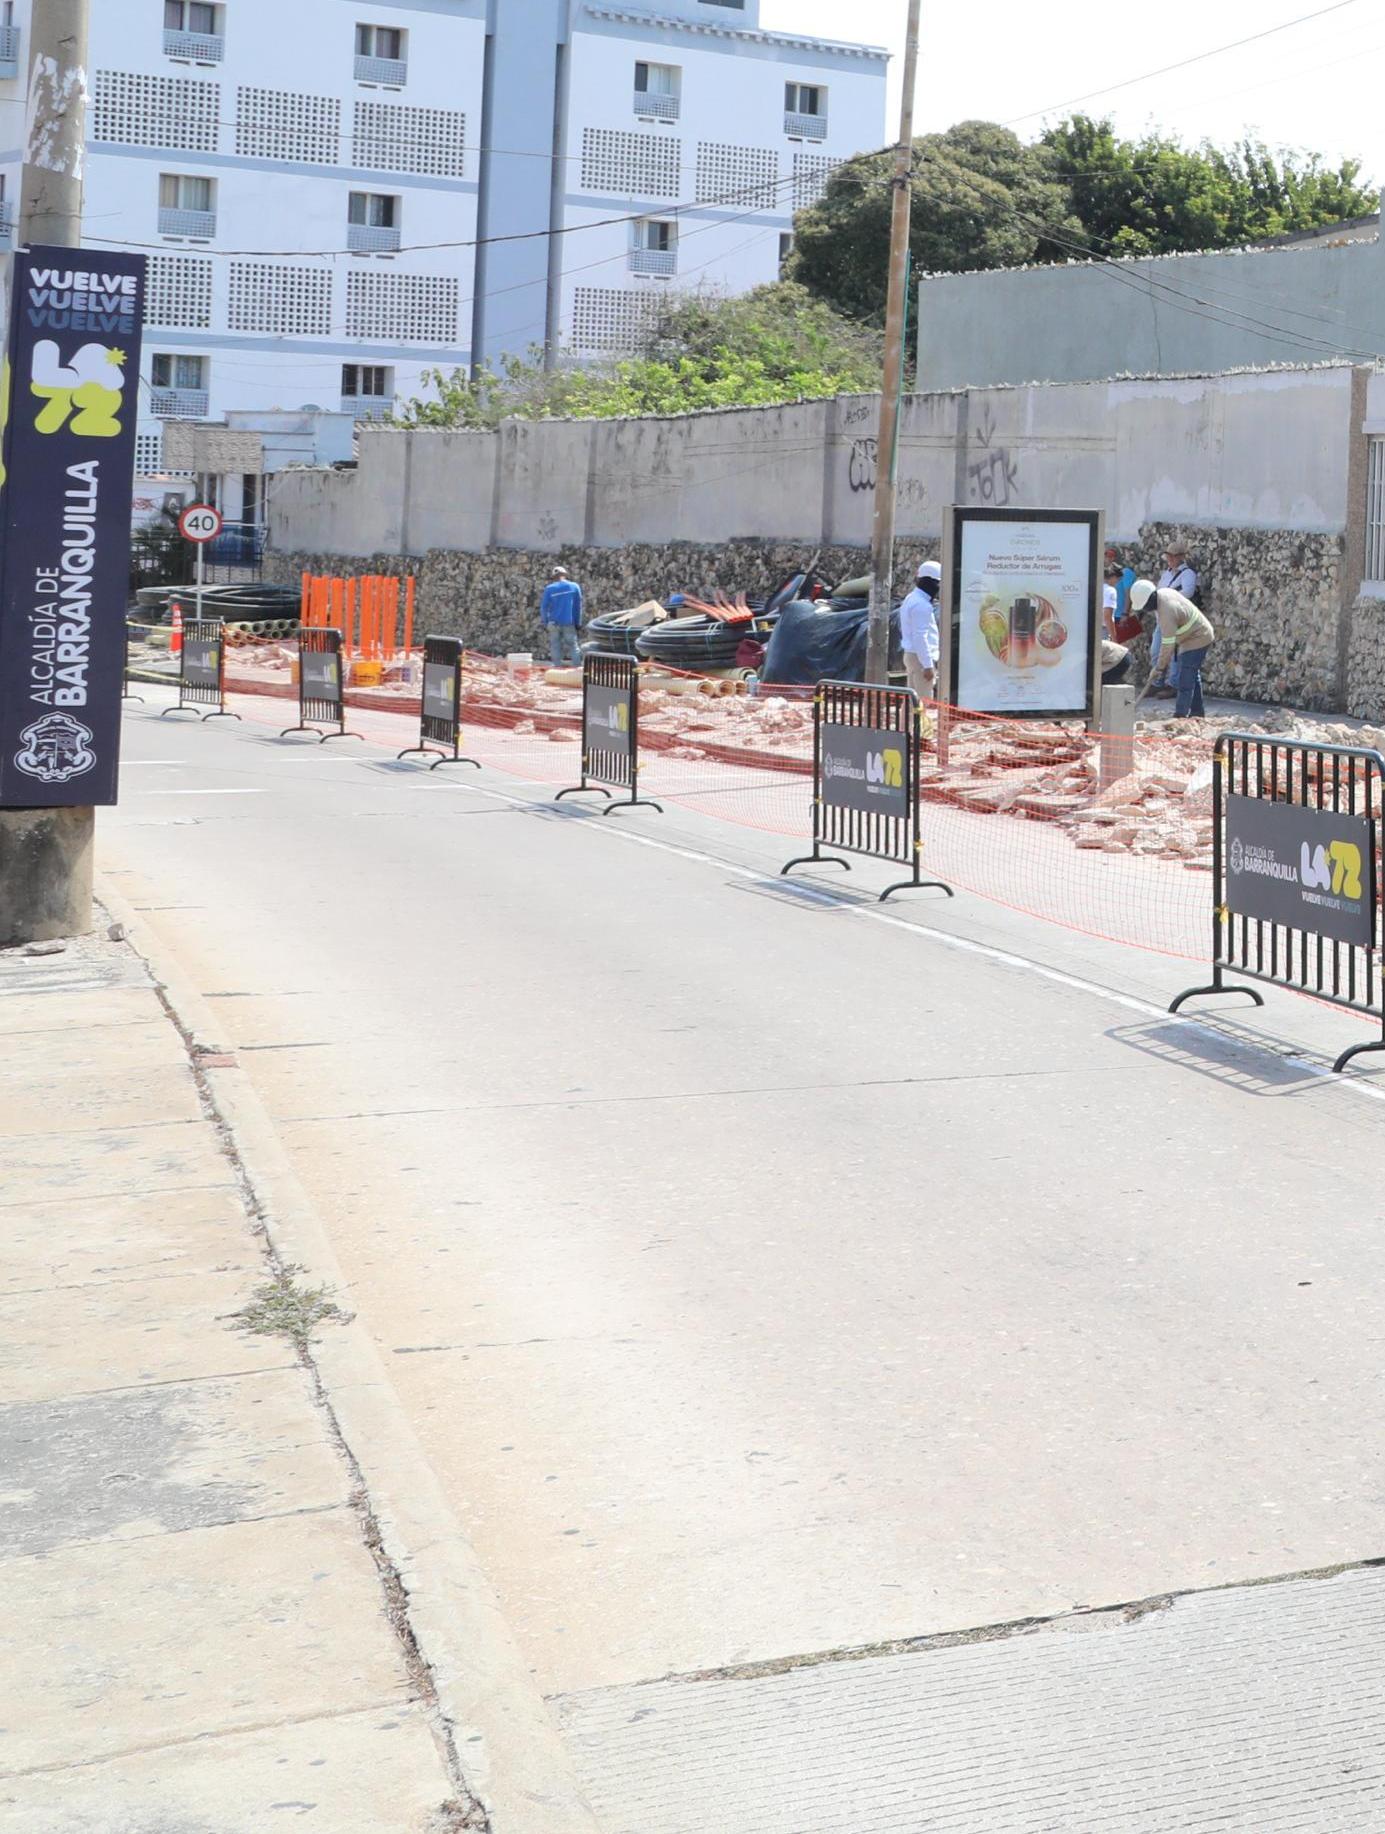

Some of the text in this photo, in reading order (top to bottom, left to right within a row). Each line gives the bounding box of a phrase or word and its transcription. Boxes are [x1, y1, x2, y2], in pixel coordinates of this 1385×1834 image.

[30, 267, 138, 295] VUELVE
[28, 288, 136, 315] VUELVE
[27, 308, 134, 335] VUELVE
[187, 515, 215, 532] 40
[54, 460, 100, 707] BARRANQUILLA
[29, 566, 60, 705] ALCALDÍA DE
[1267, 849, 1275, 861] DE
[1244, 855, 1298, 883] BARRANQUILLA
